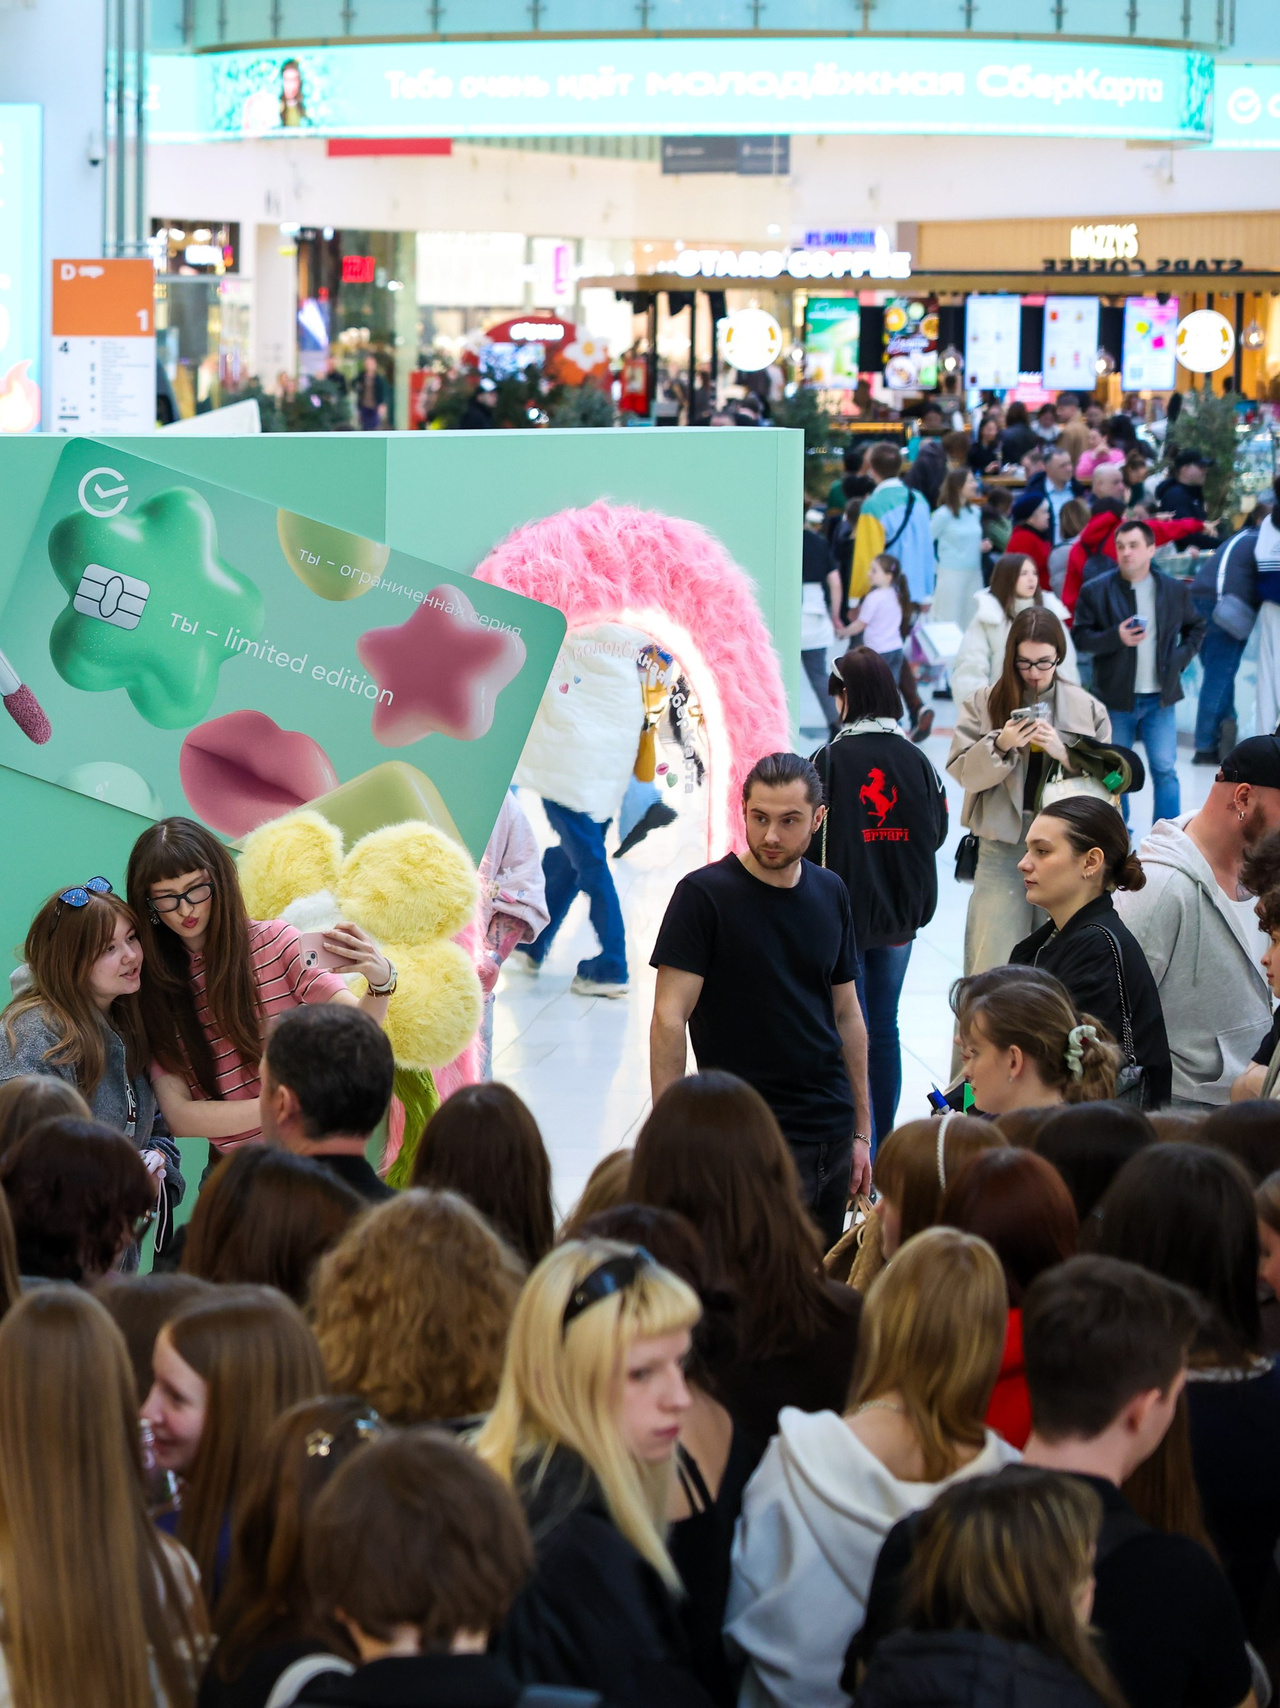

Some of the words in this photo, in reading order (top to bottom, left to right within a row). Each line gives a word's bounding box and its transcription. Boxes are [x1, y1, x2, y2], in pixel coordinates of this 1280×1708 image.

[385, 67, 454, 99] Тебе
[459, 73, 550, 99] очень
[557, 65, 634, 100] идёт
[646, 62, 965, 101] молодёжная
[976, 64, 1163, 107] СберКарта
[60, 263, 77, 280] D
[675, 250, 784, 279] STARS
[136, 308, 149, 332] 1
[299, 548, 321, 566] ты
[339, 564, 466, 617] ограниченная
[471, 610, 522, 638] серия
[170, 612, 199, 636] ты
[224, 627, 308, 674] limited
[311, 667, 395, 706] edition
